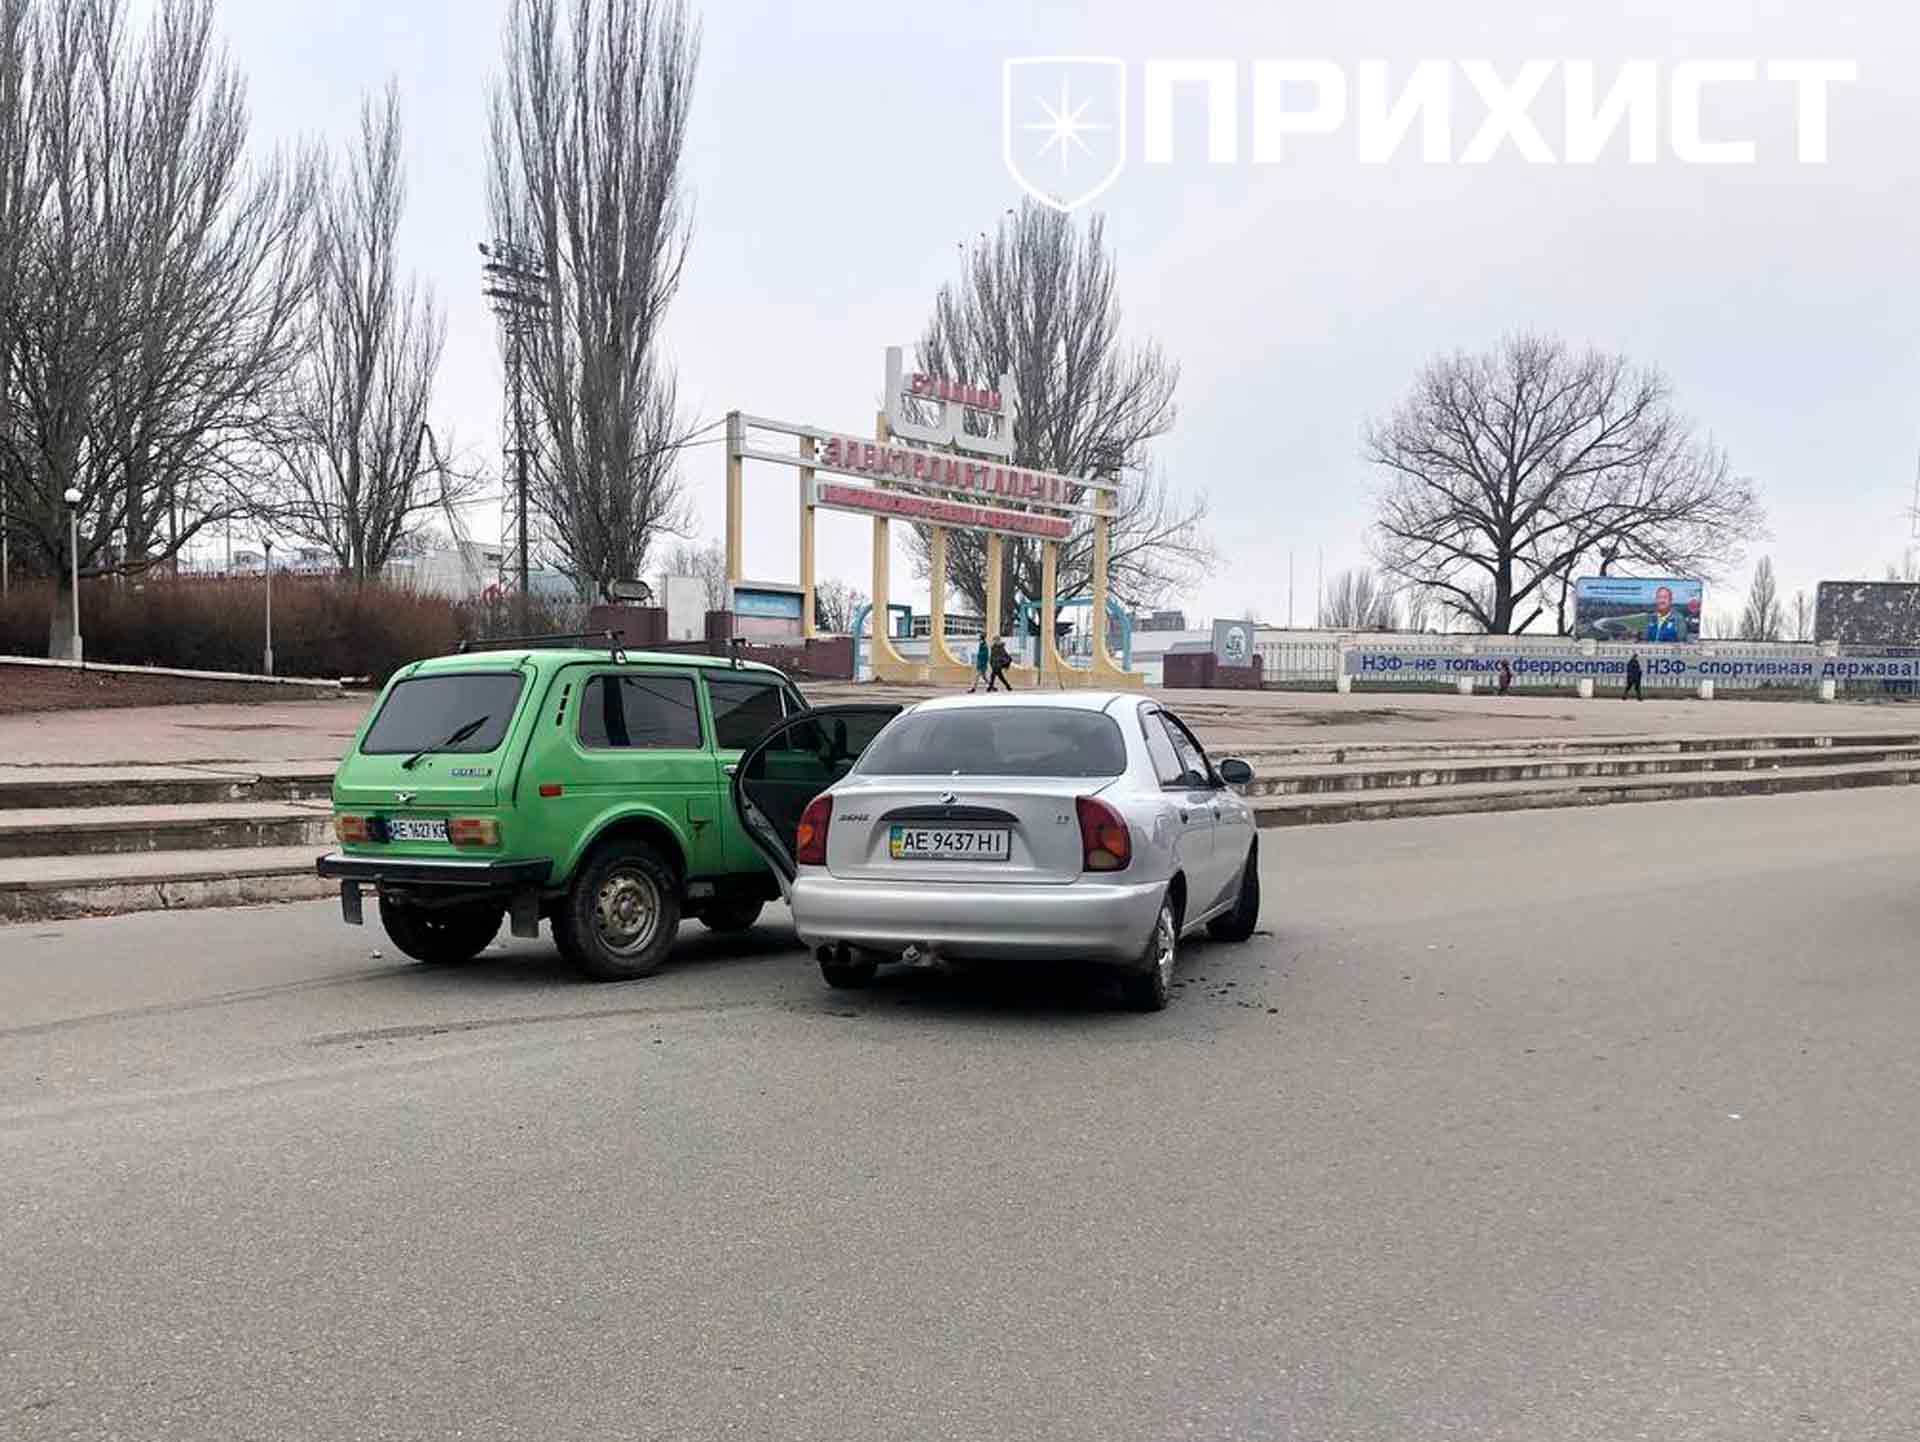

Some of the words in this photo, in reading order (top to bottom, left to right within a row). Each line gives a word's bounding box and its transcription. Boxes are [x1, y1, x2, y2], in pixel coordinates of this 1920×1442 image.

[1512, 656, 1641, 676] ферросплав
[904, 831, 929, 850] AE
[932, 832, 974, 851] 9437
[977, 833, 1000, 852] HI
